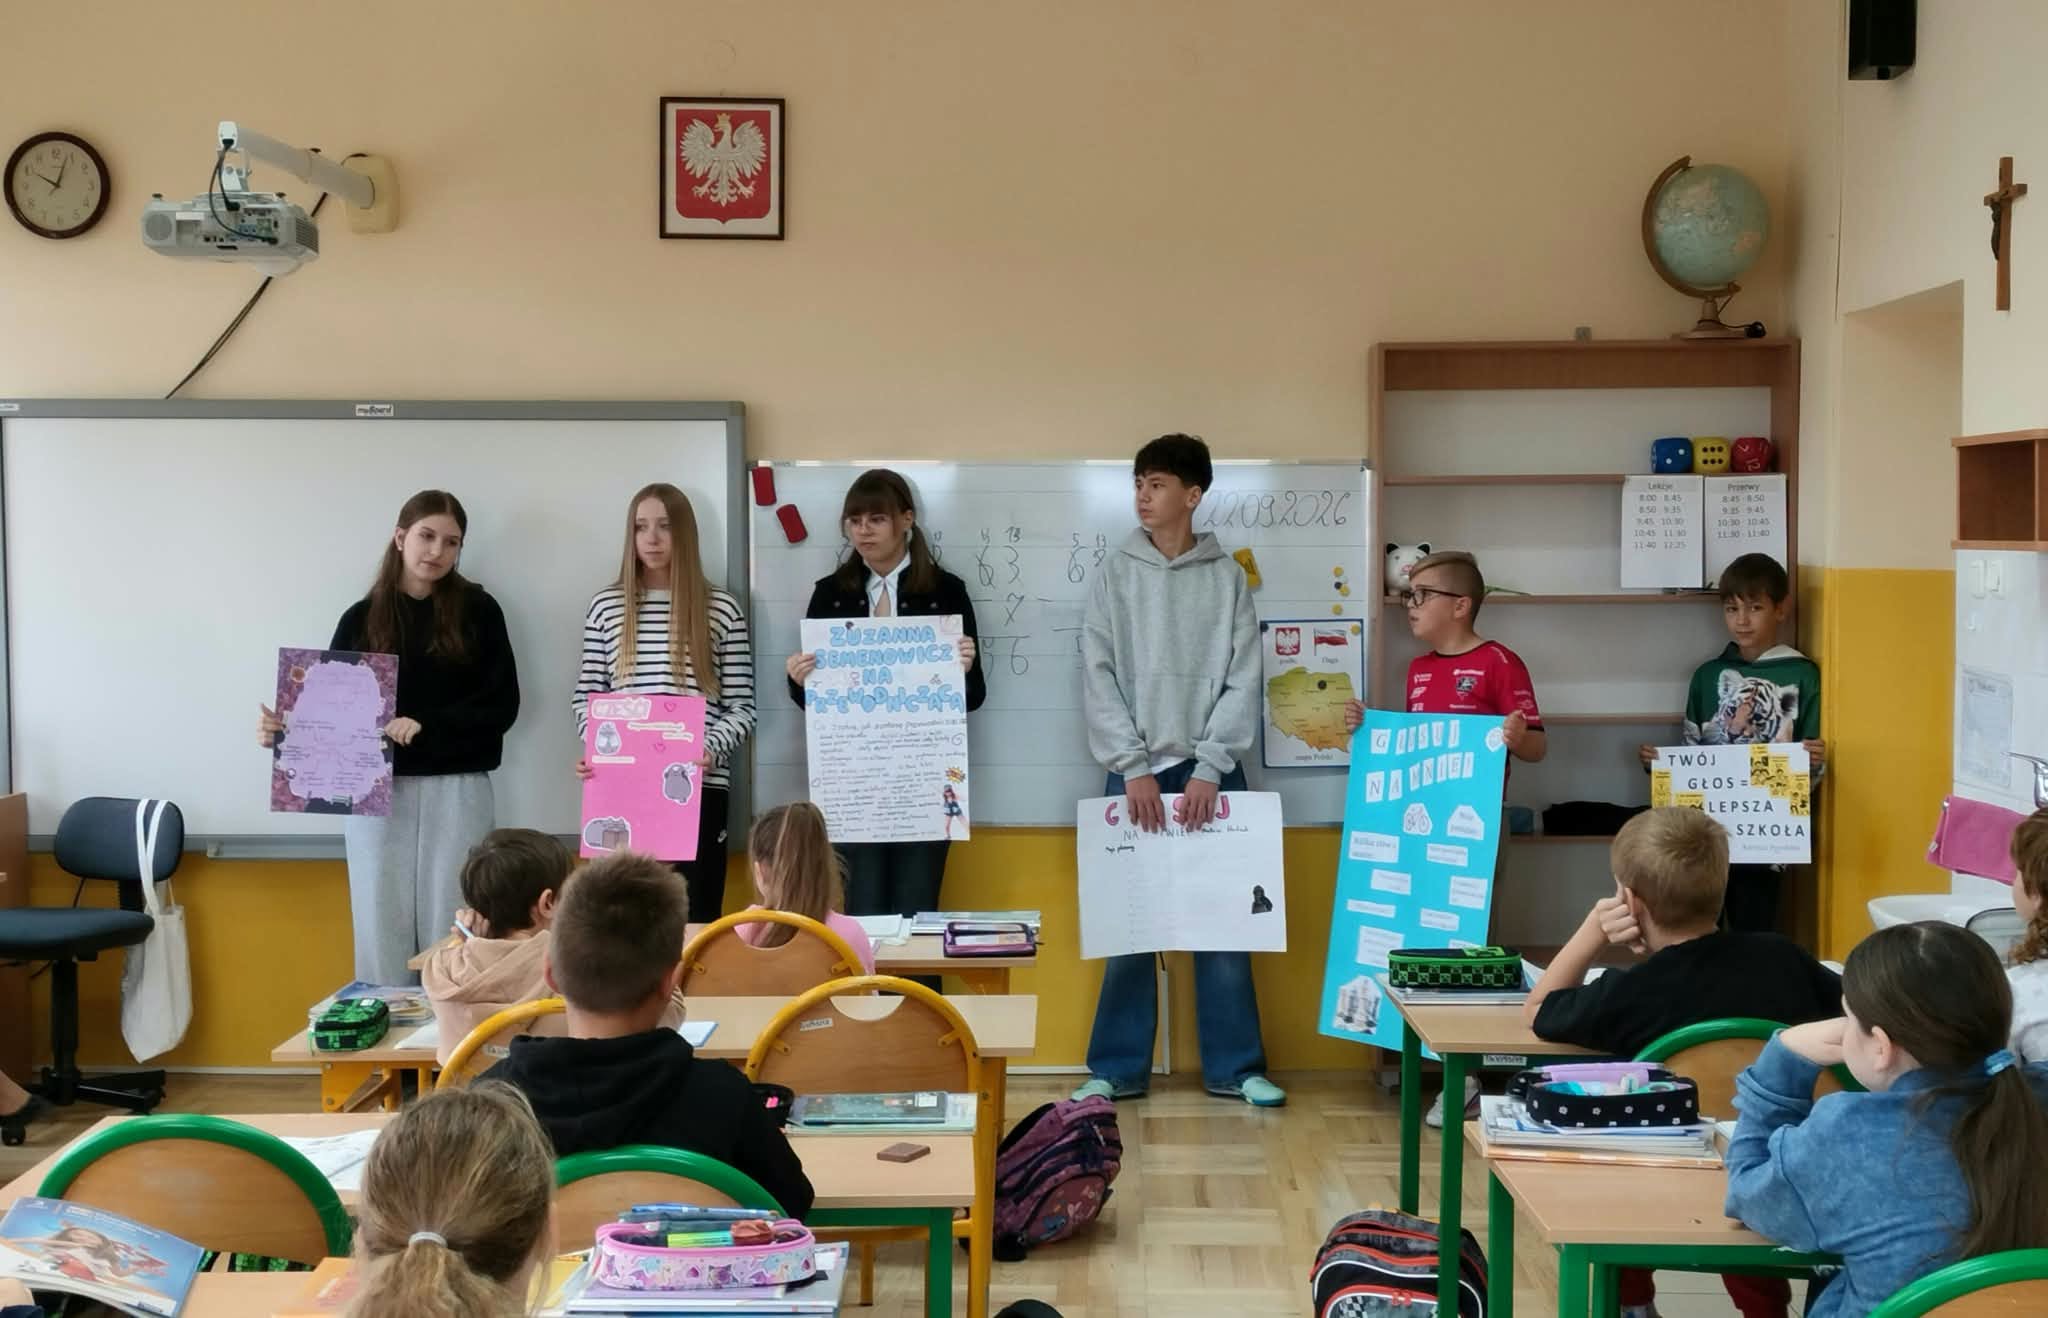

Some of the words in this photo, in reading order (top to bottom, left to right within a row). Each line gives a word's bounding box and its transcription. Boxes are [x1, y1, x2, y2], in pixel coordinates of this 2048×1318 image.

[830, 624, 936, 647] ZUZANNA
[862, 666, 893, 685] NA
[1668, 752, 1716, 766] TWÓJ
[1688, 777, 1734, 790] GŁOS
[1709, 801, 1774, 813] LEPSZA
[1736, 824, 1805, 836] SZKOŁA
